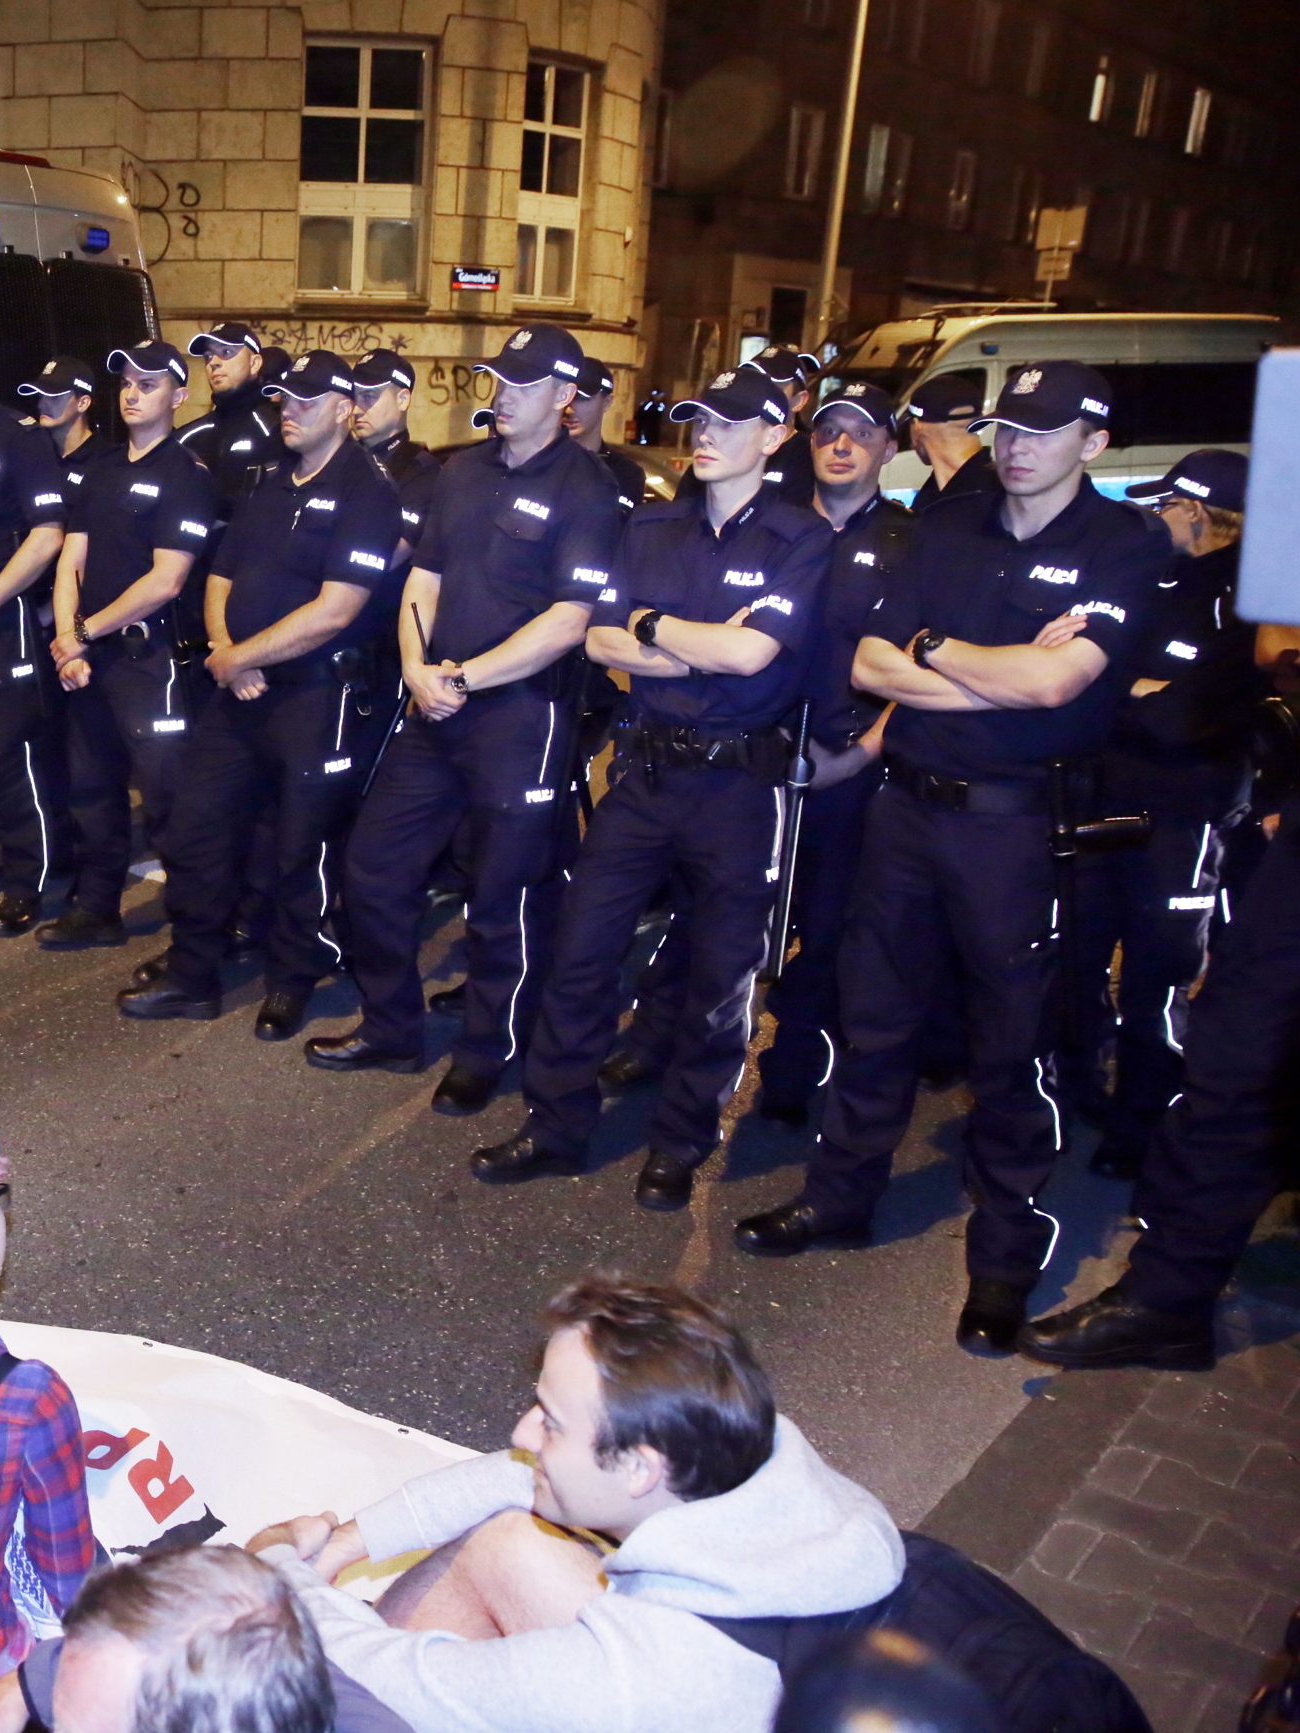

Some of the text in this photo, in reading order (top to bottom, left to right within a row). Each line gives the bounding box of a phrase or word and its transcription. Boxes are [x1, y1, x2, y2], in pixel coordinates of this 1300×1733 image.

[763, 399, 786, 424] POLICJA
[1080, 397, 1111, 418] POLICJA
[512, 497, 550, 521] POLICJA
[349, 550, 386, 571] POLICJA
[572, 567, 609, 585] POLICJ
[723, 569, 765, 587] POLICJA
[749, 594, 794, 617] POLICJA
